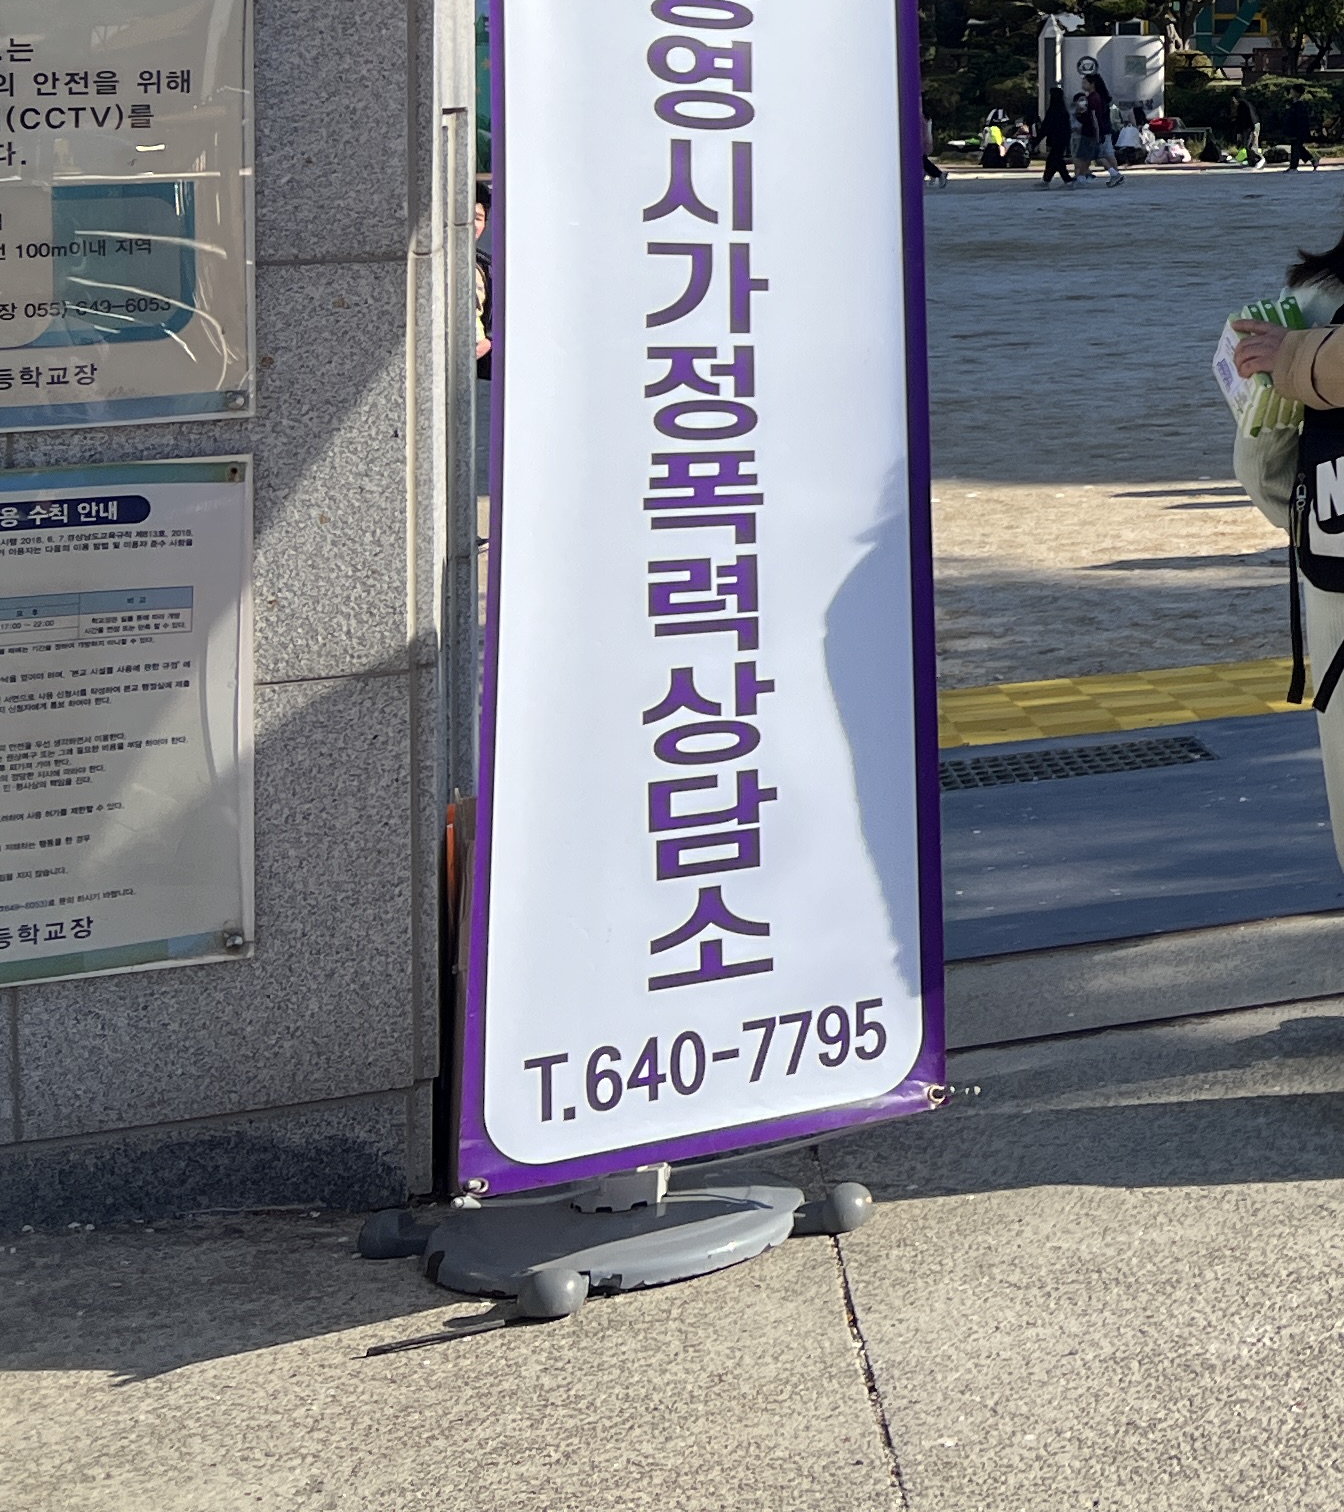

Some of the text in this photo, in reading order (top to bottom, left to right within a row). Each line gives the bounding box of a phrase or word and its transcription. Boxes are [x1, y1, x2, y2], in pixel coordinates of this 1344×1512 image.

[0, 38, 34, 63] 는
[33, 70, 119, 96] 안전을
[137, 69, 191, 94] 위해
[6, 104, 154, 133] (CCTV)를
[16, 240, 106, 259] 100m이내
[115, 238, 152, 255] 지역
[28, 503, 69, 525] 수칙
[77, 501, 119, 522] 안내
[524, 999, 887, 1123] T.640-7795
